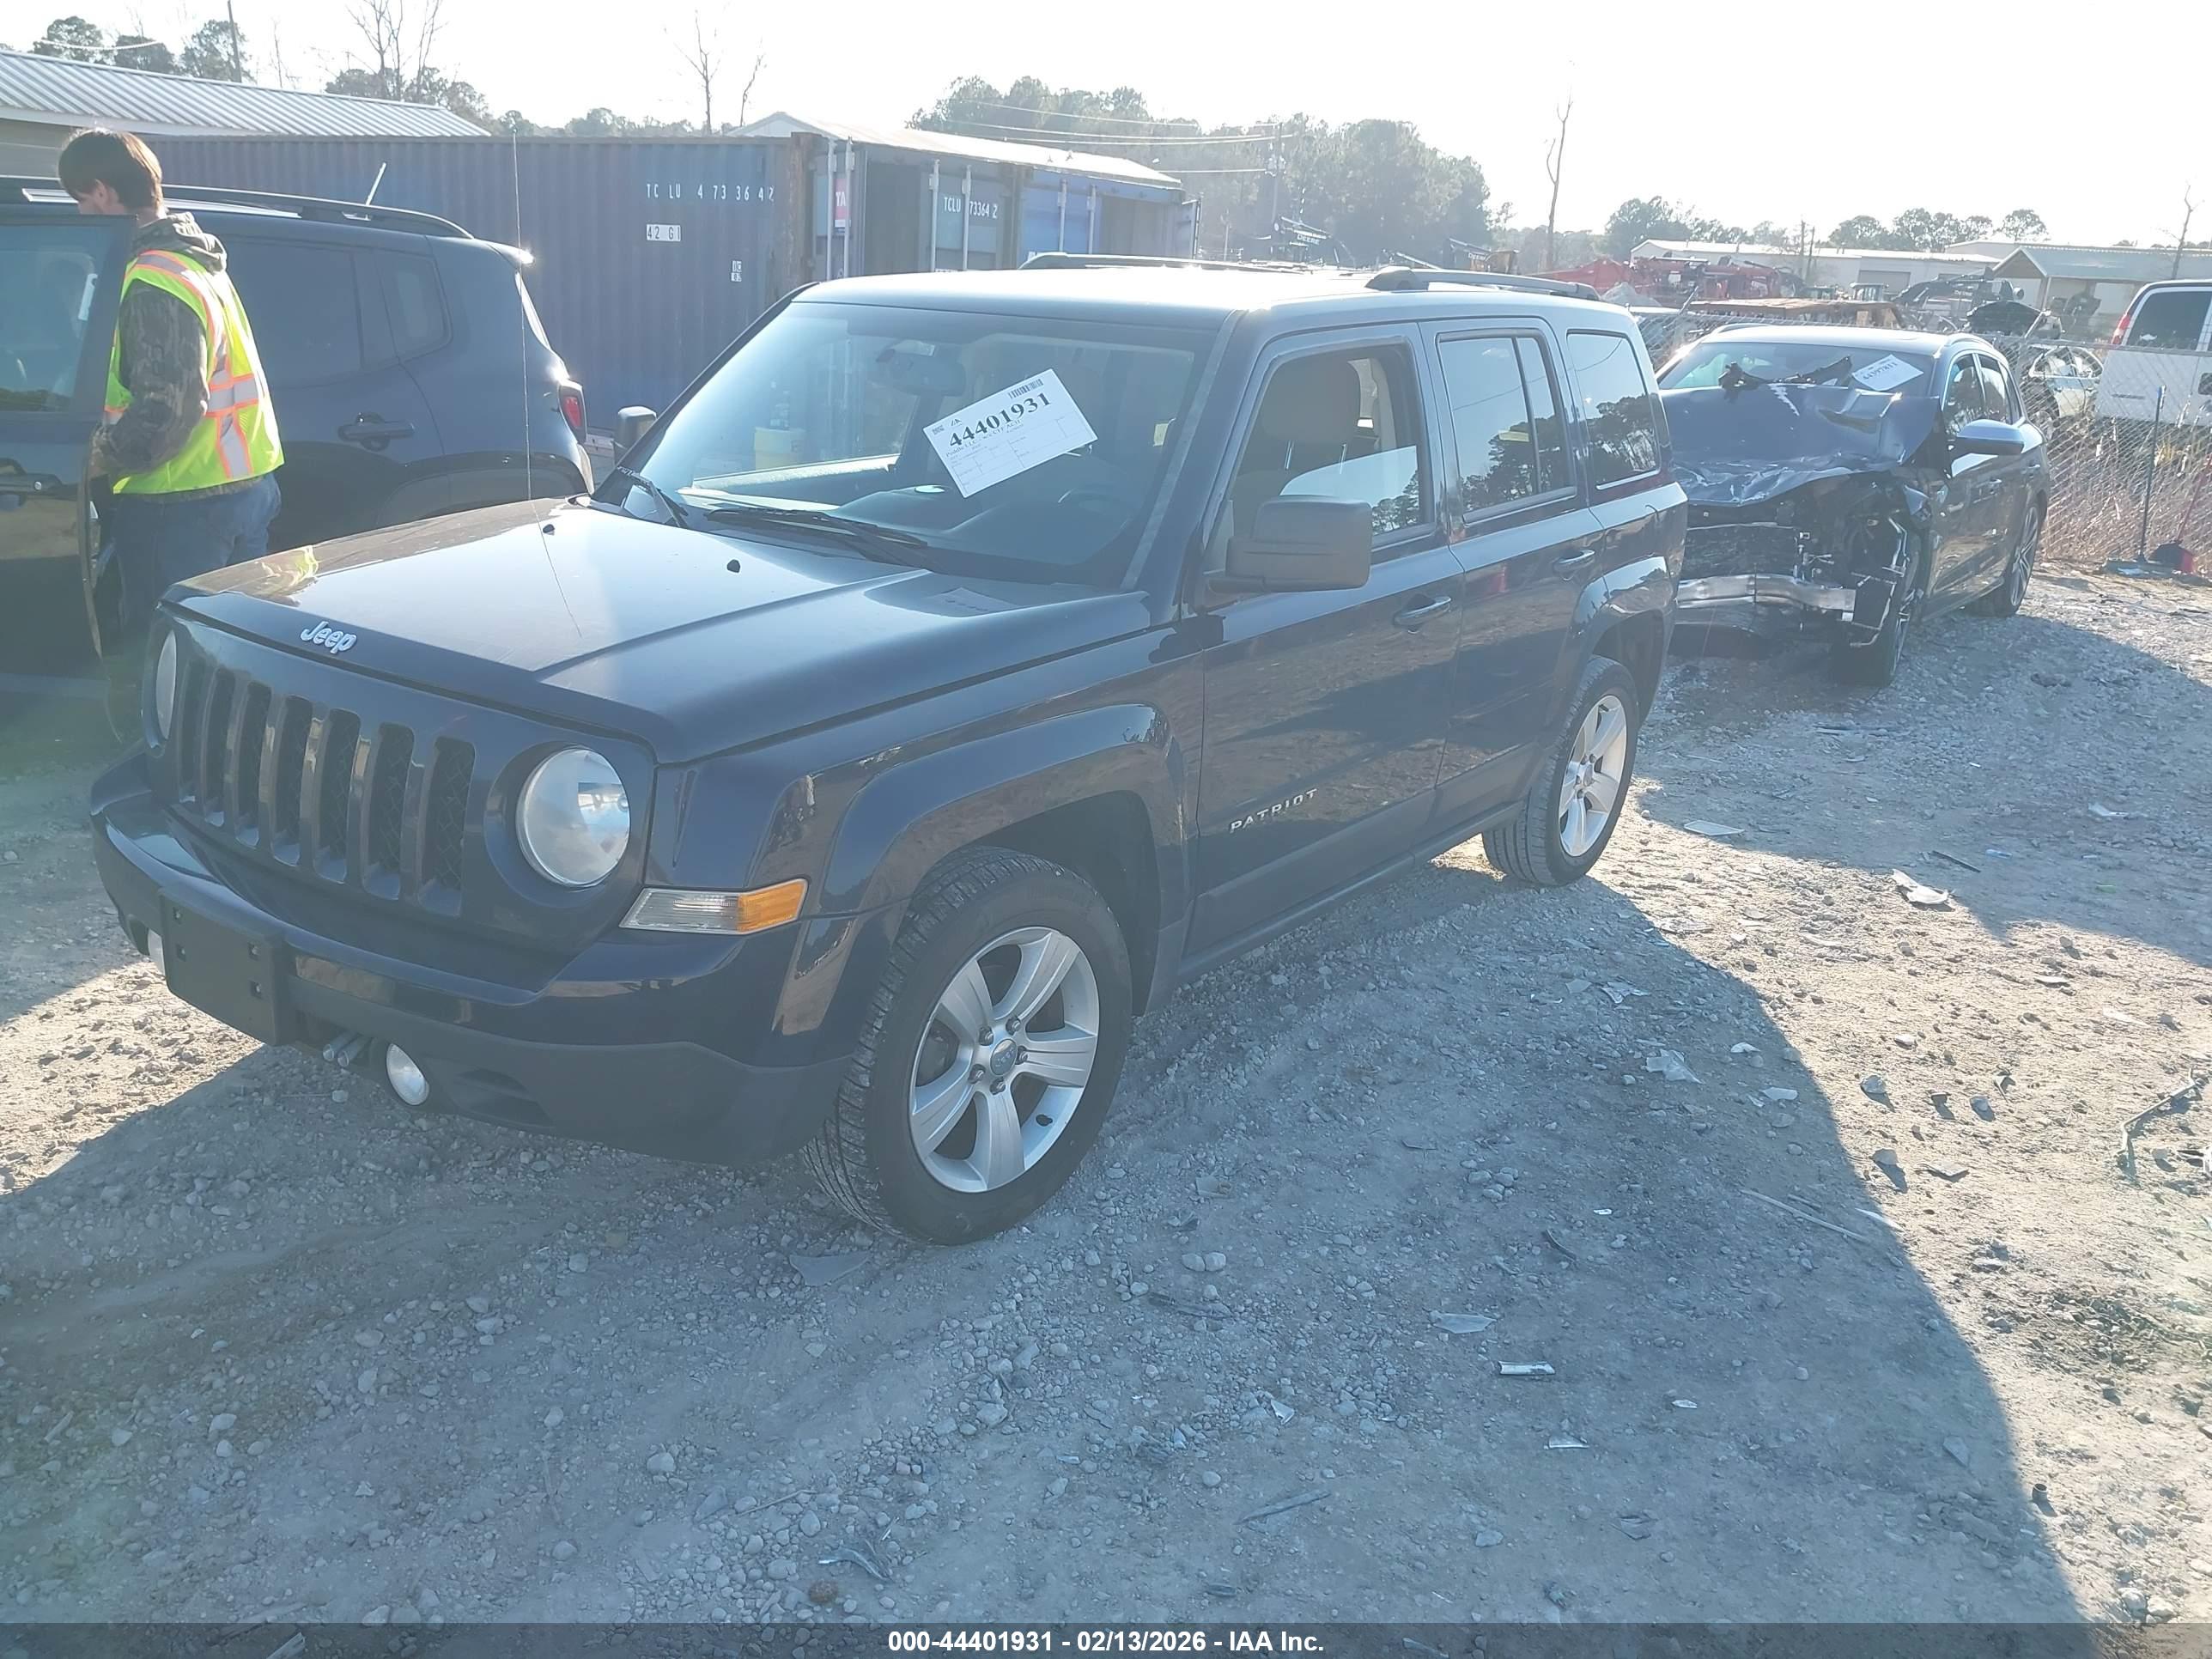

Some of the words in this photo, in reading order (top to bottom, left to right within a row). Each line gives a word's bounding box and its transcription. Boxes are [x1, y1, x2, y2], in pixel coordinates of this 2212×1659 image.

[944, 196, 961, 213] TCLU
[950, 392, 1051, 447] 44401931
[301, 621, 357, 654] Jeep
[1230, 788, 1317, 834] PATRIOT
